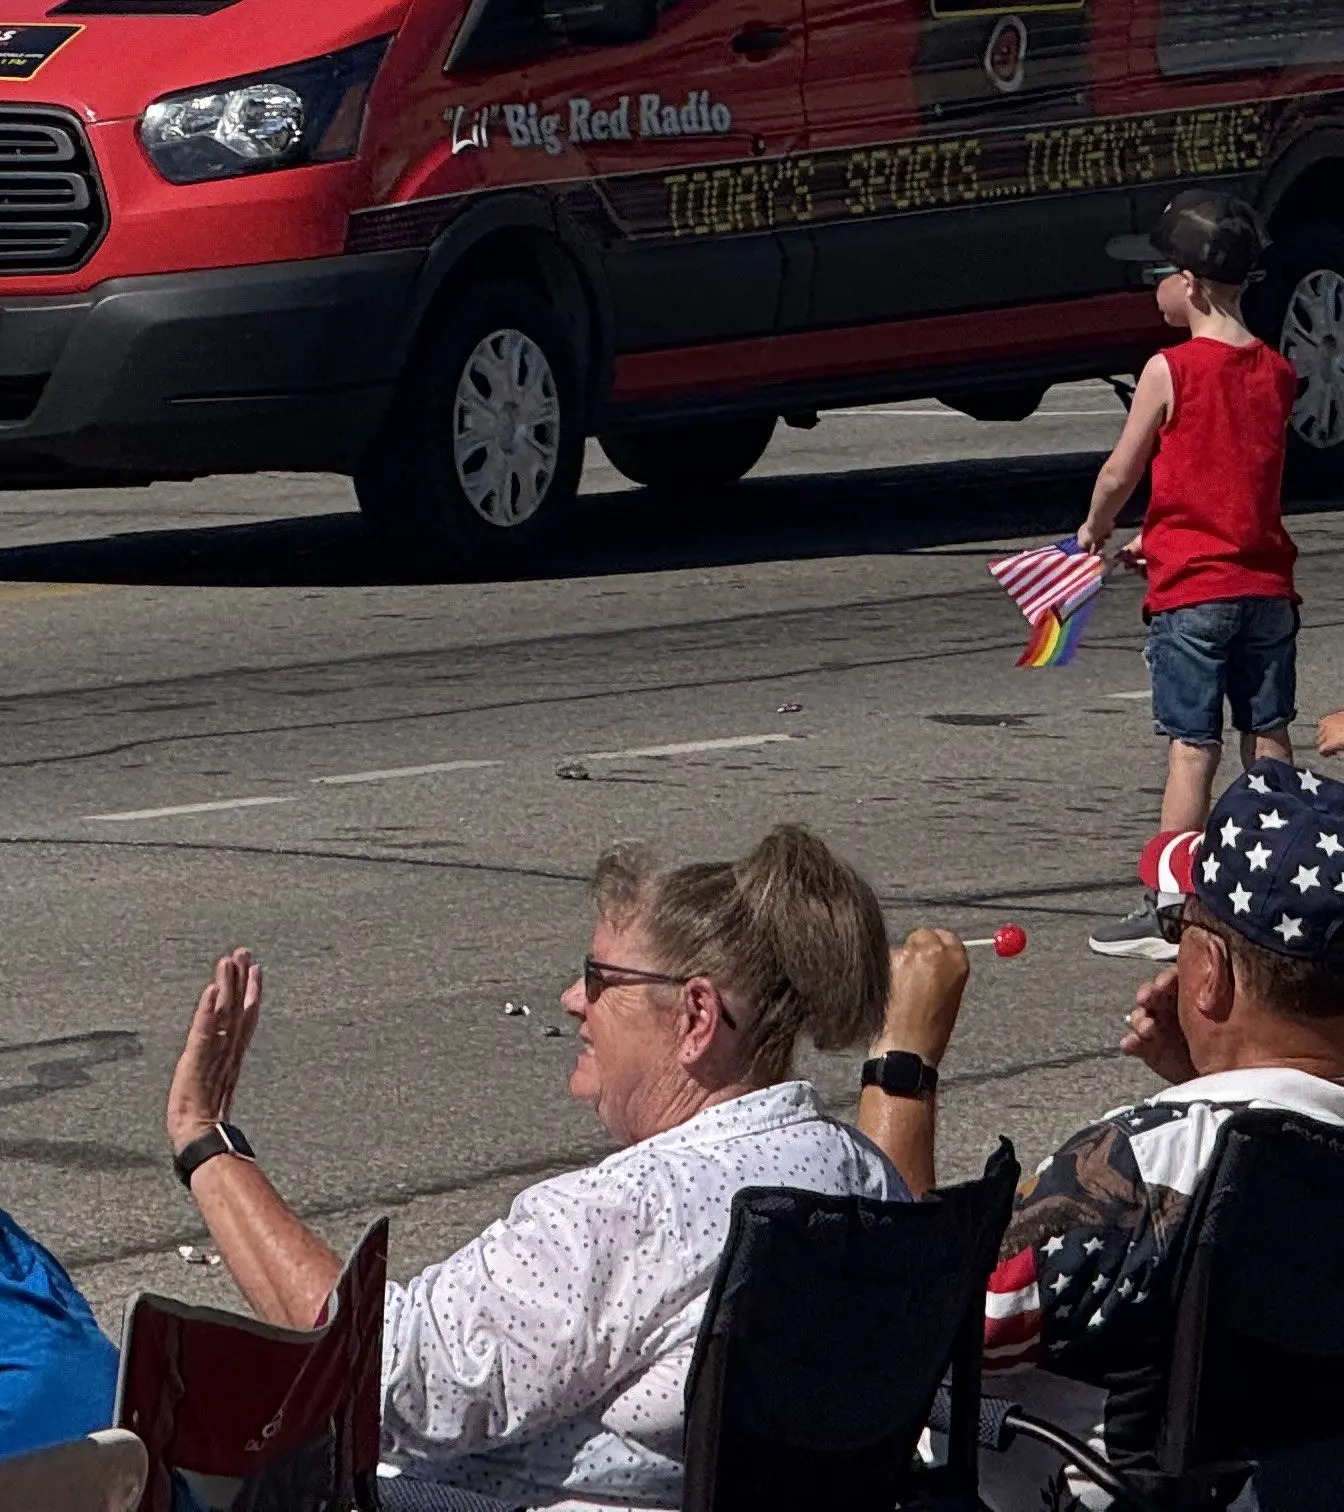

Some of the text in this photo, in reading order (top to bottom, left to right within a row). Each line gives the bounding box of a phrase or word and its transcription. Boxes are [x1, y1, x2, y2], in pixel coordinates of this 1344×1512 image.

[504, 103, 563, 155] Big
[568, 95, 632, 143] Red
[640, 90, 732, 136] Radio
[664, 156, 815, 237] TODAY'S
